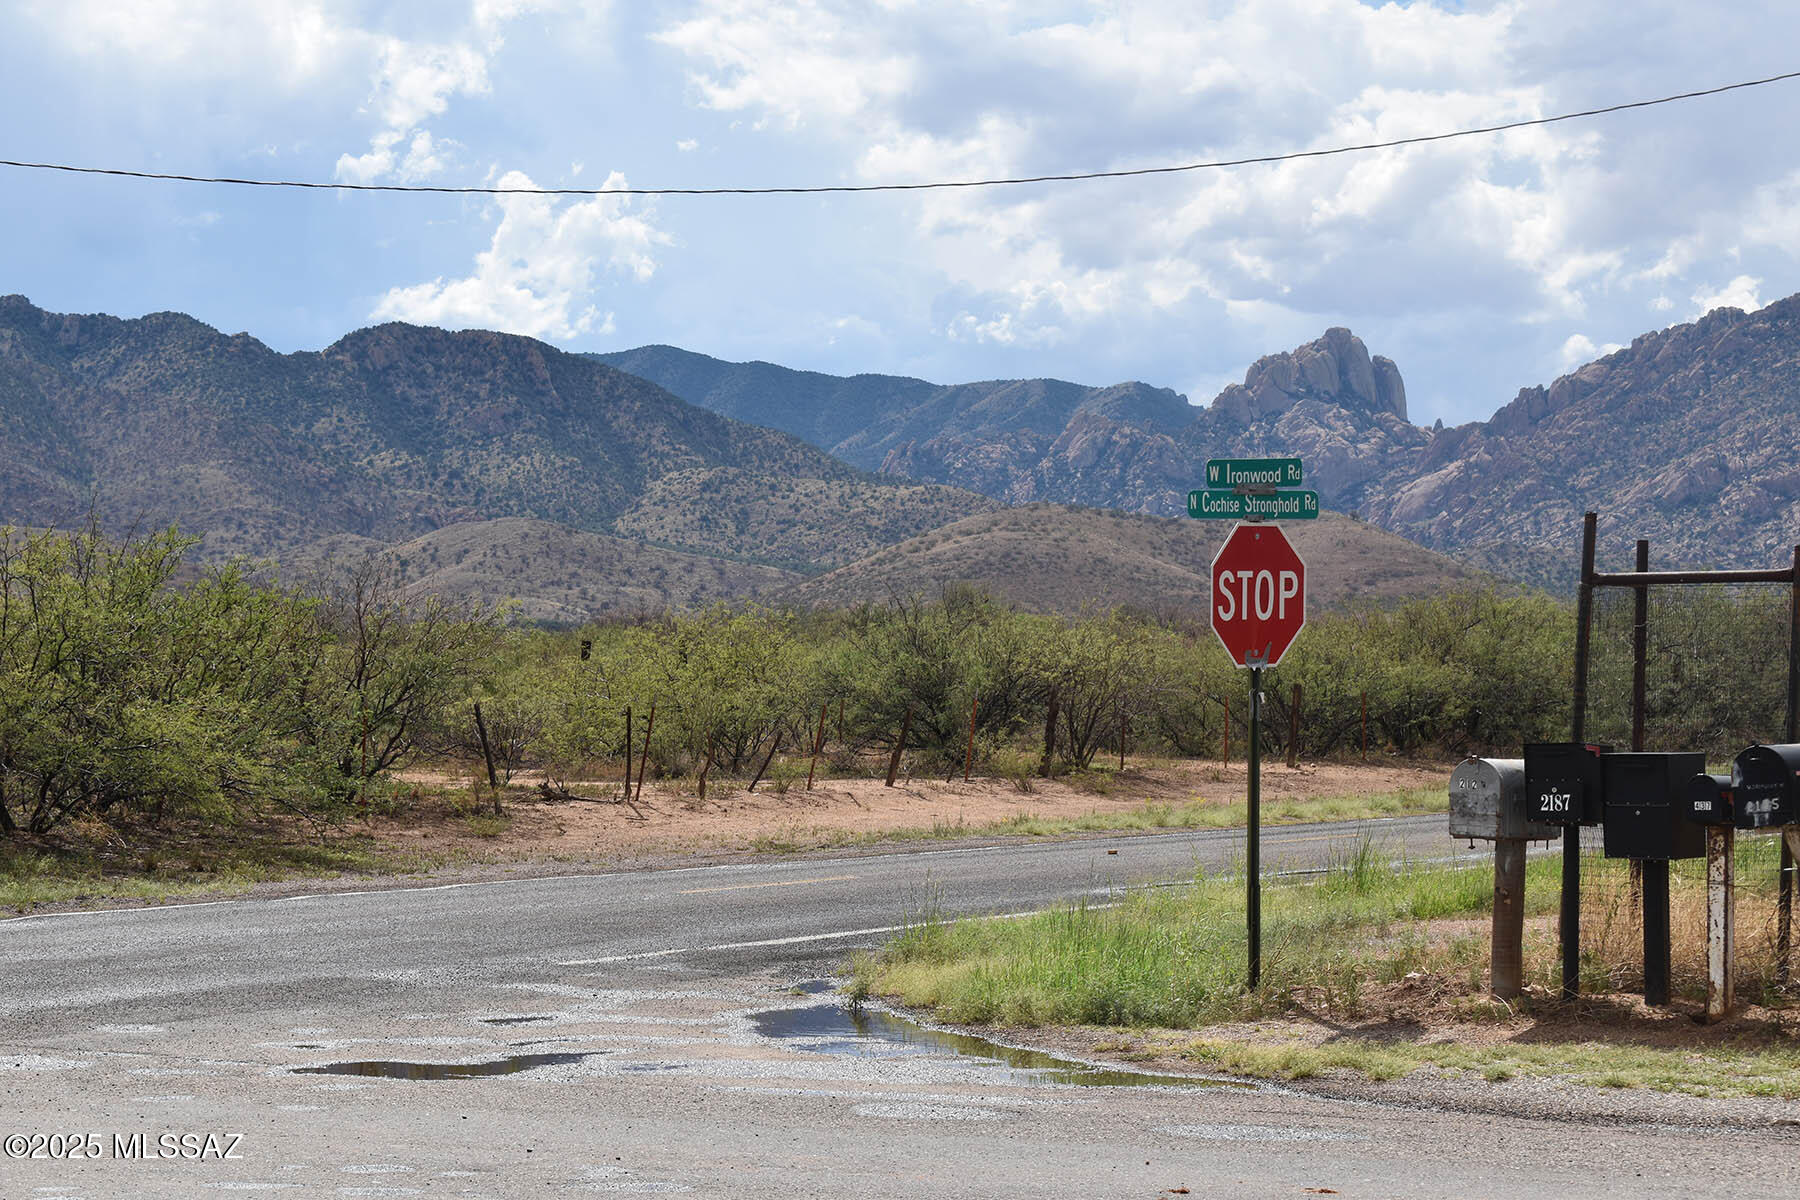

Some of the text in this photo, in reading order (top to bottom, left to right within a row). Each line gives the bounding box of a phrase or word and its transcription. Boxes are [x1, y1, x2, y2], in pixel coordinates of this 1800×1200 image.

[1209, 463, 1301, 484] W Ironwood Rd
[1190, 492, 1316, 517] N Cochise Stronghold Rd
[1217, 569, 1299, 622] STOP
[1540, 793, 1571, 812] 2187
